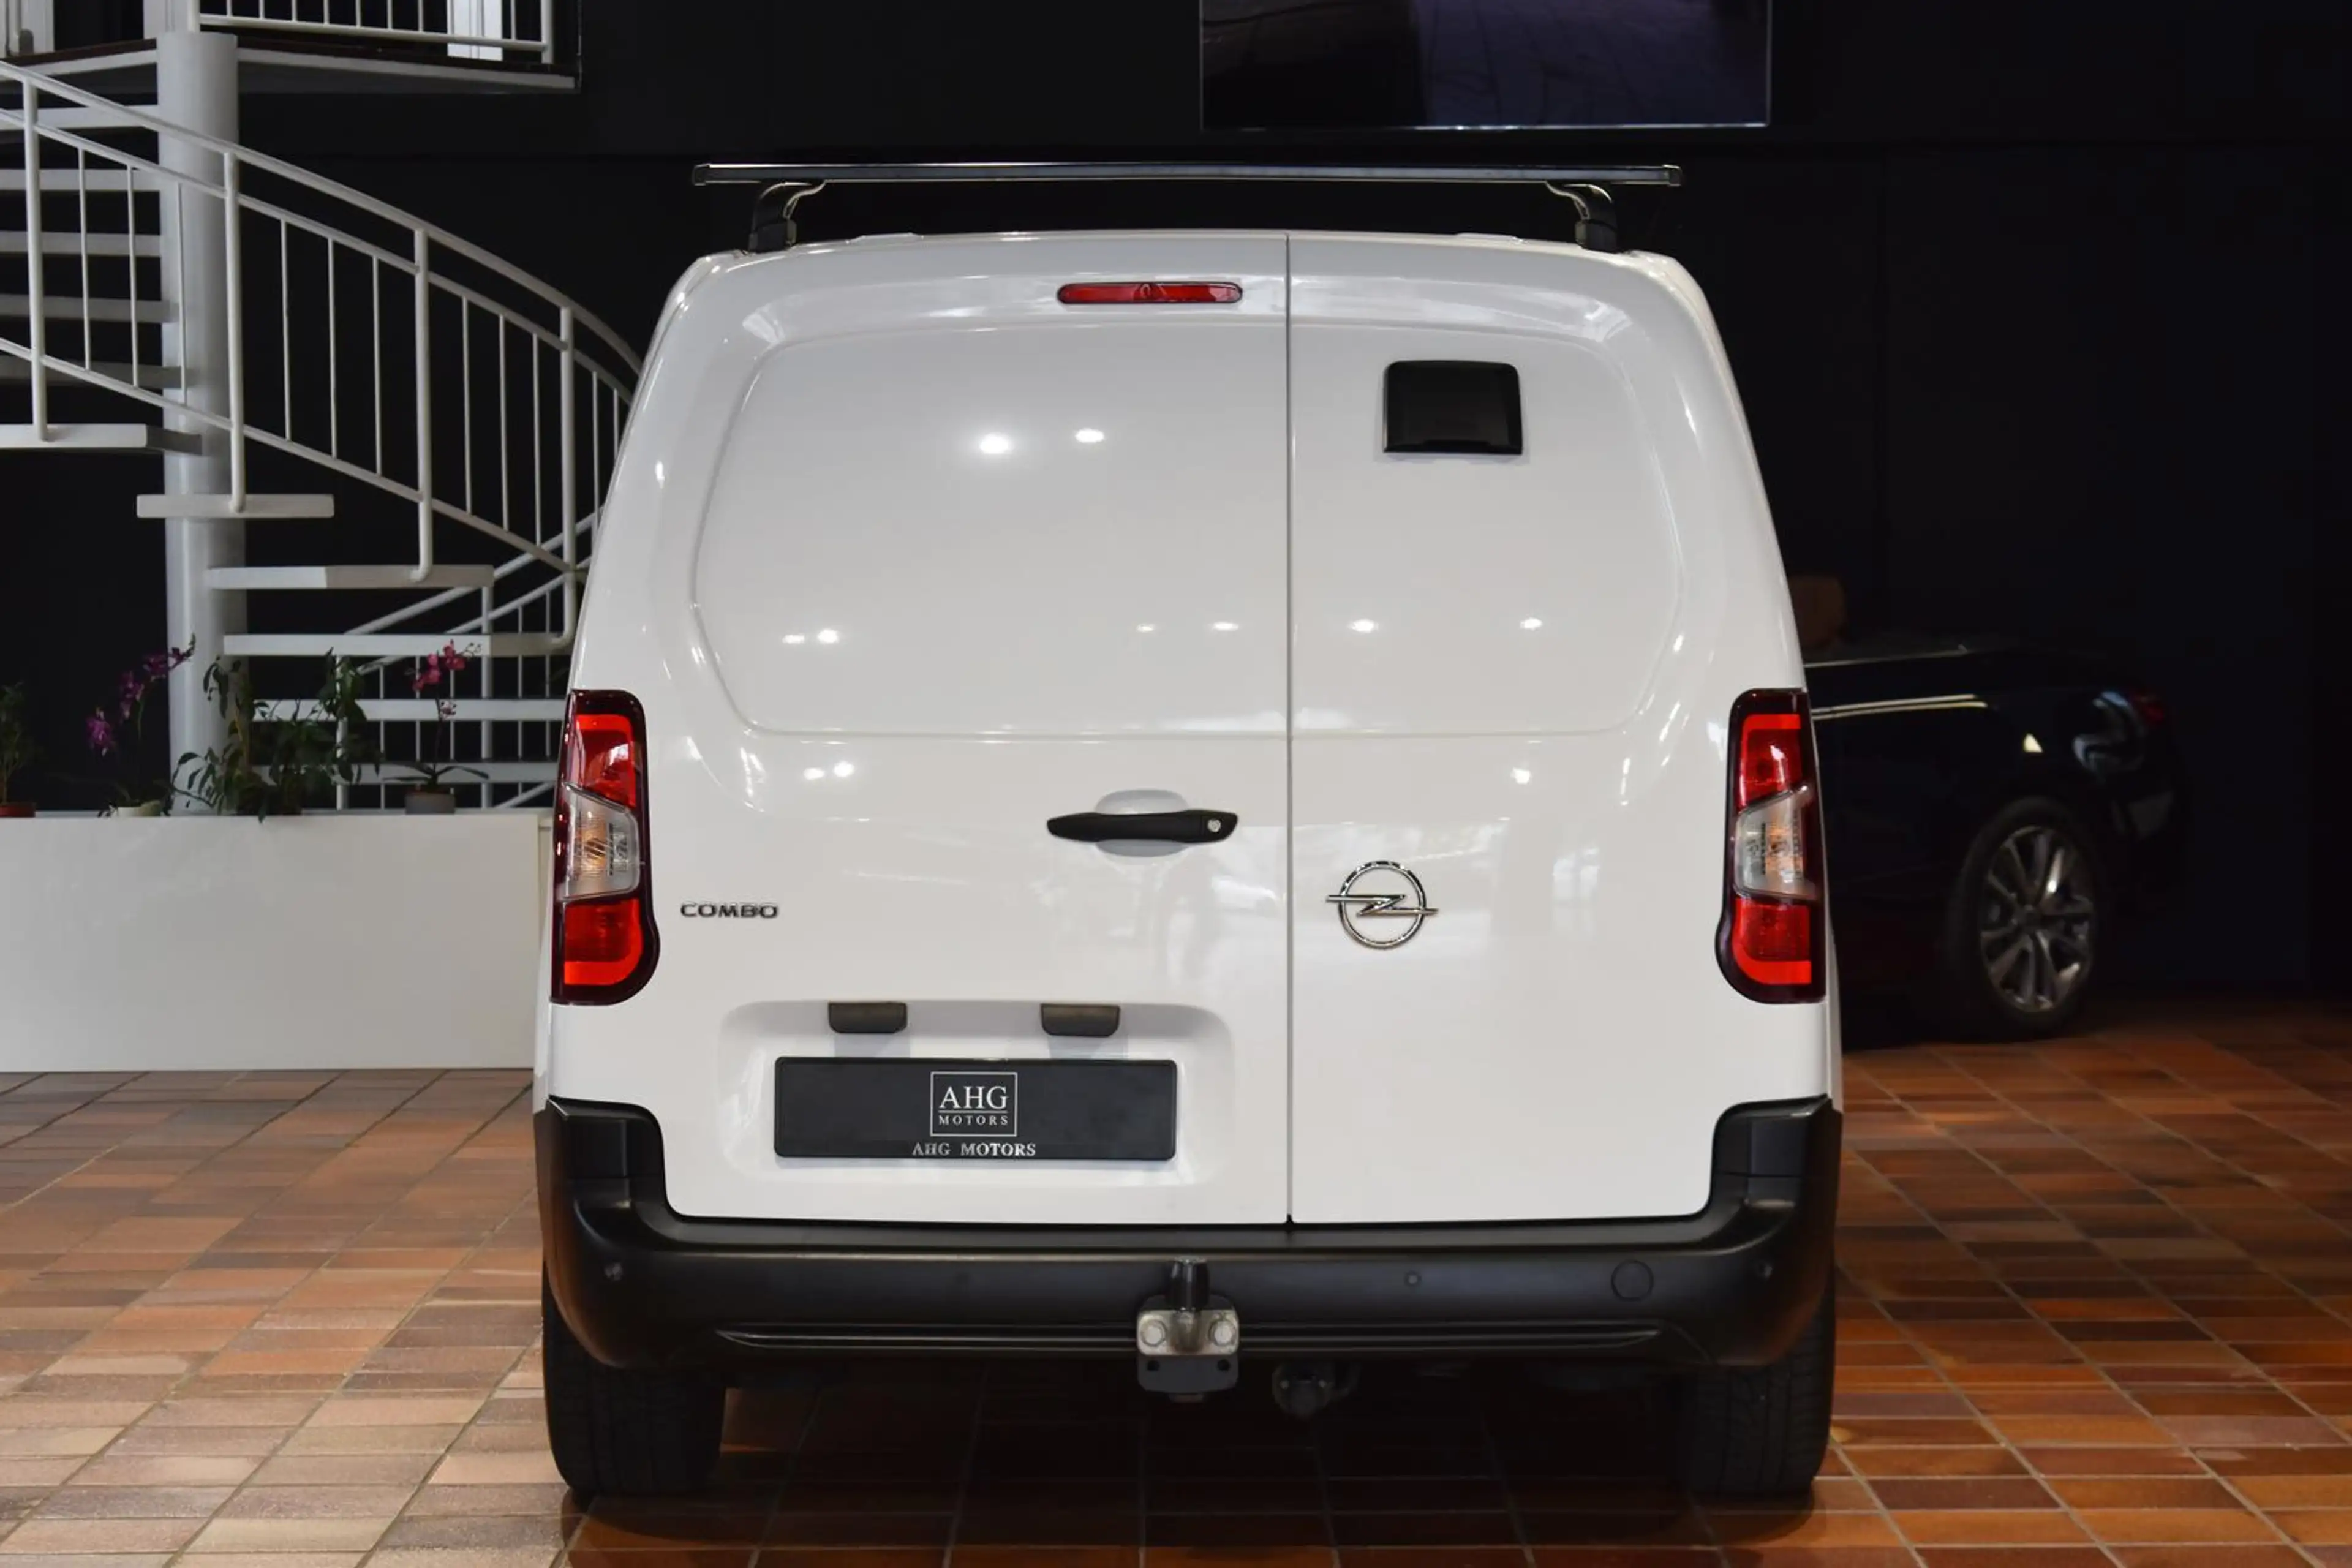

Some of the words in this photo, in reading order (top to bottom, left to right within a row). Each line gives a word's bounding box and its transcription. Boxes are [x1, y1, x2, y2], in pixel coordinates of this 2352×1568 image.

[680, 903, 778, 919] COMBO
[939, 1086, 1009, 1109] AHG
[938, 1115, 1008, 1125] MOTORS
[912, 1142, 951, 1156] AHG
[960, 1142, 1036, 1156] MOTORS
